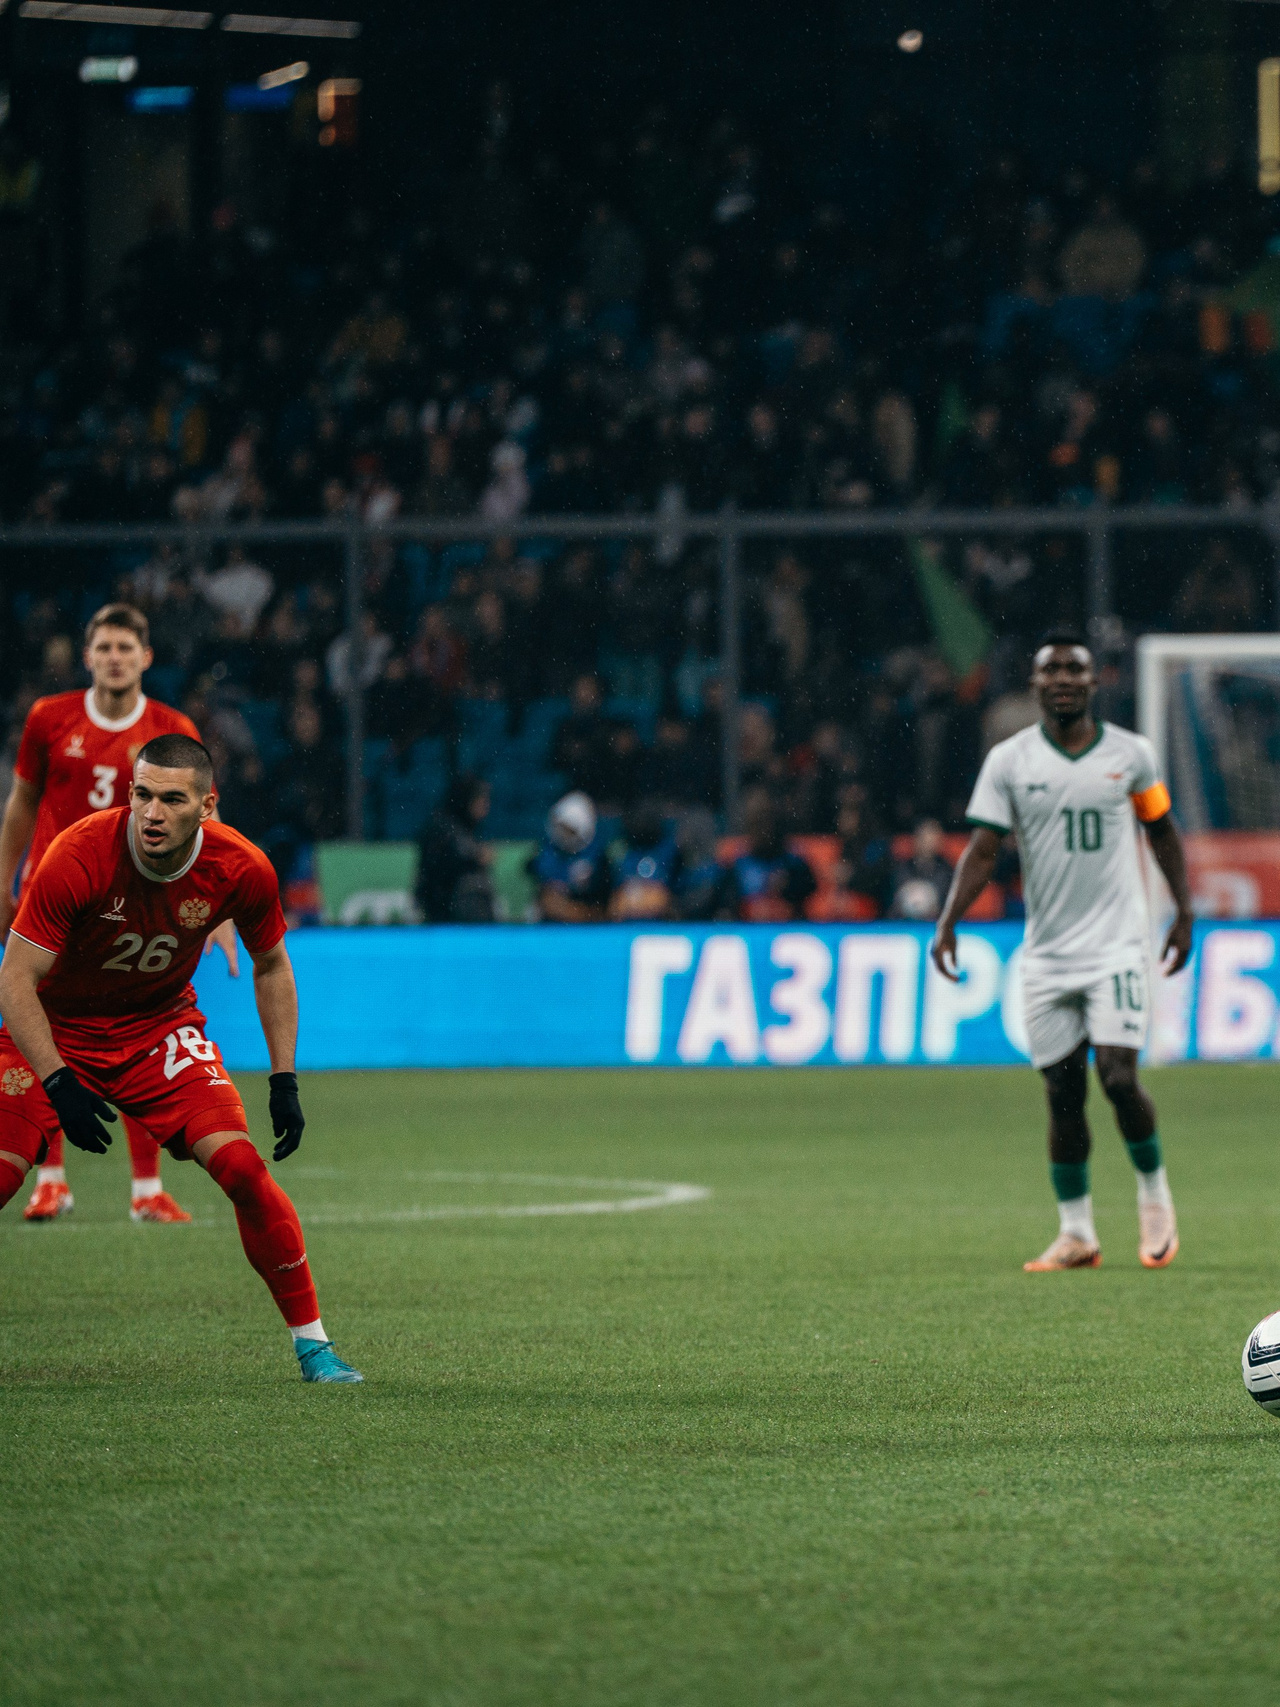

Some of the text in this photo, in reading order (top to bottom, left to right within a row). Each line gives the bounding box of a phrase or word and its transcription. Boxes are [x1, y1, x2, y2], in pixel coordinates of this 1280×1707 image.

[88, 764, 118, 810] 3
[1060, 806, 1102, 852] 10
[101, 932, 179, 973] 26
[1110, 970, 1142, 1011] 10
